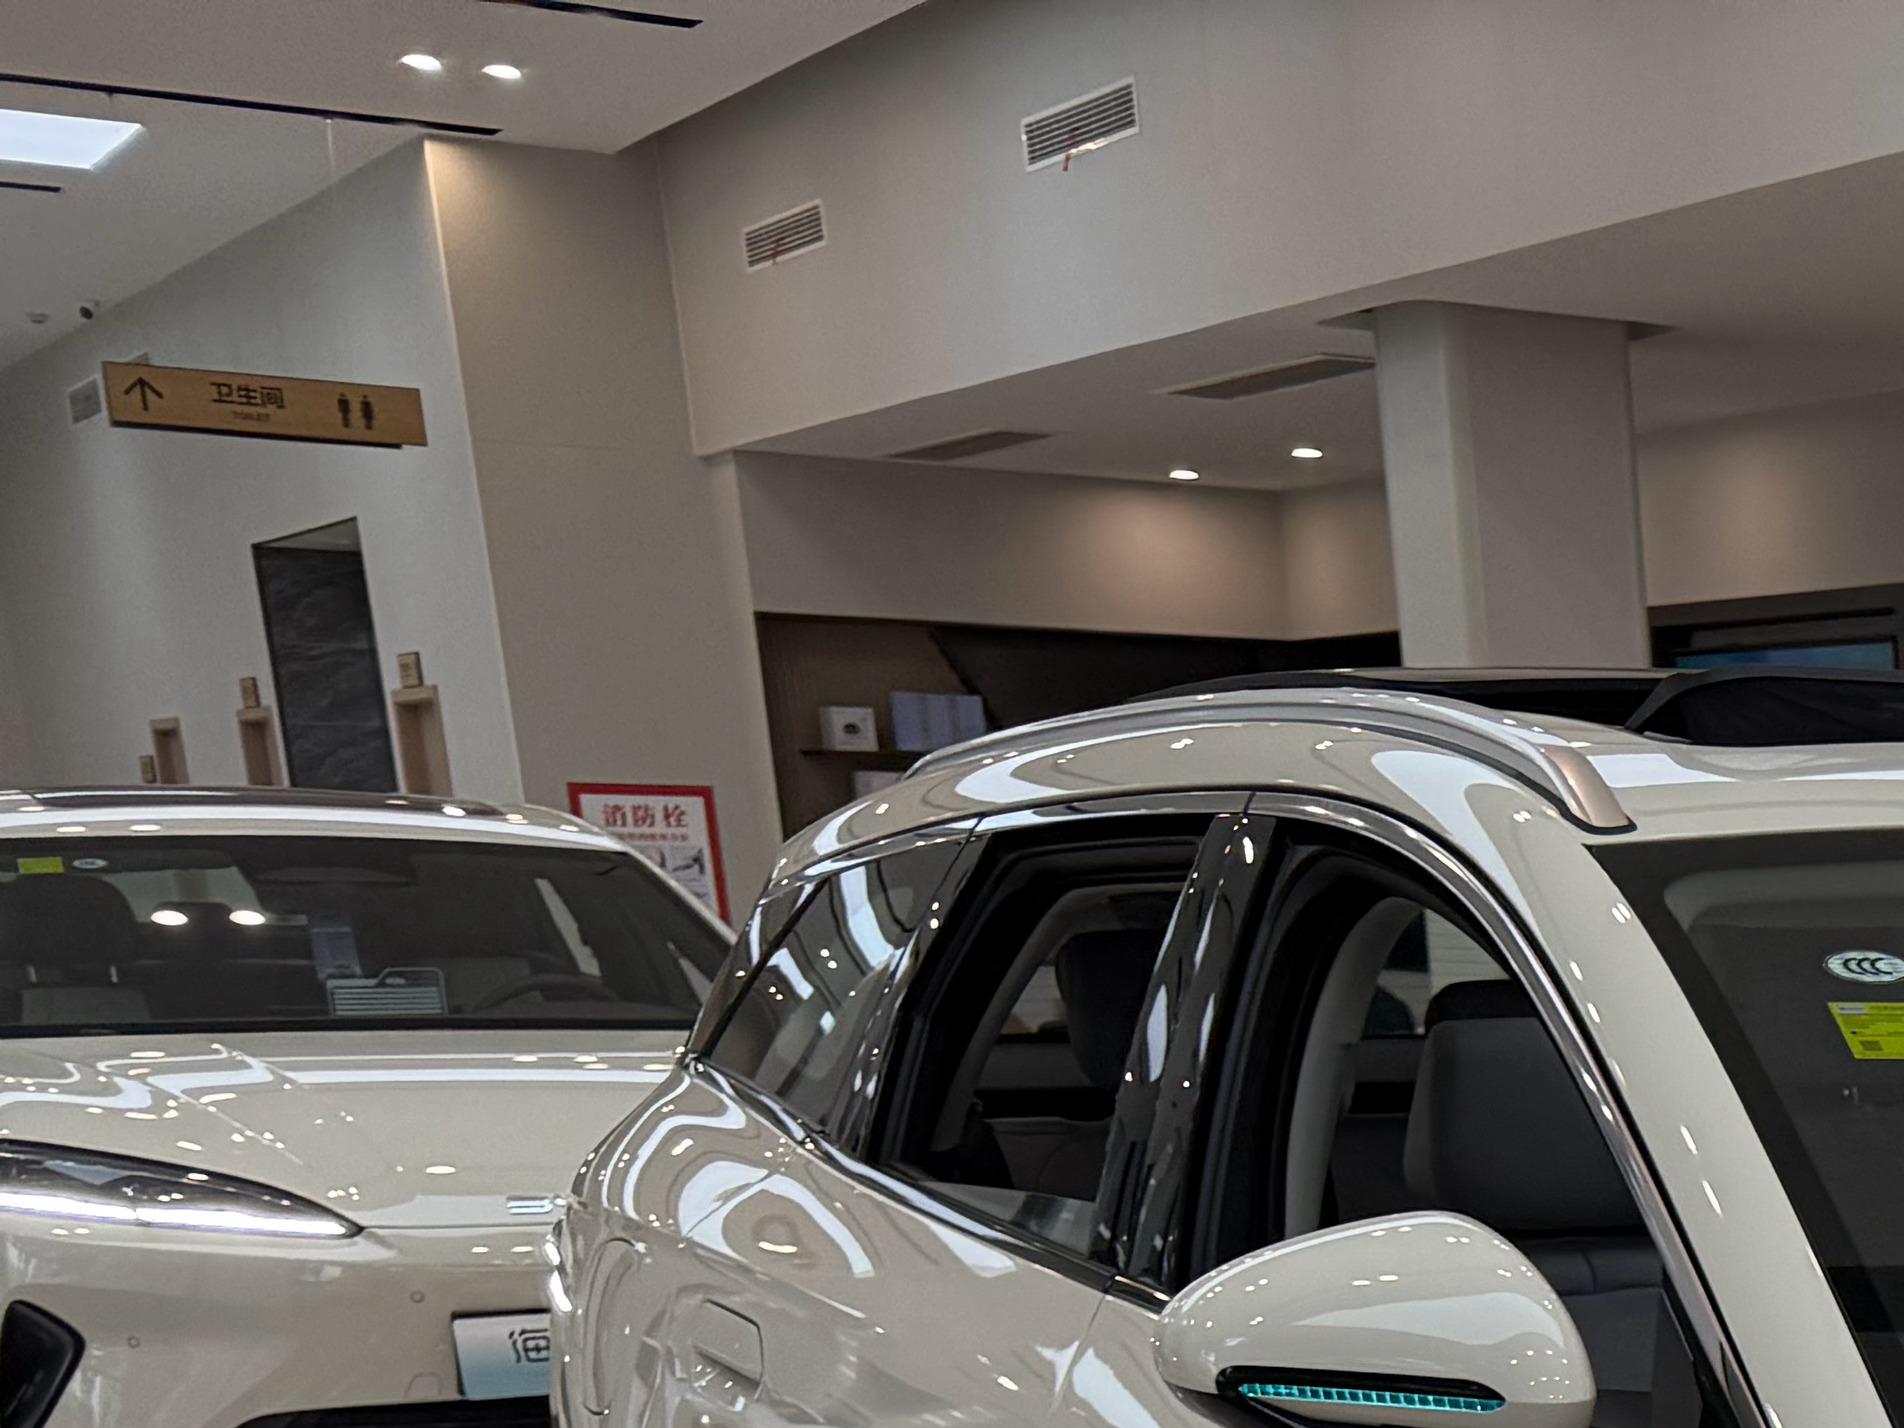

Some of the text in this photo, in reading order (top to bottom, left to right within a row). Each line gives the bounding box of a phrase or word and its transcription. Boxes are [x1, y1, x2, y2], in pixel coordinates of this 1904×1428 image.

[210, 381, 285, 411] 卫生间
[603, 803, 688, 828] 消防栓
